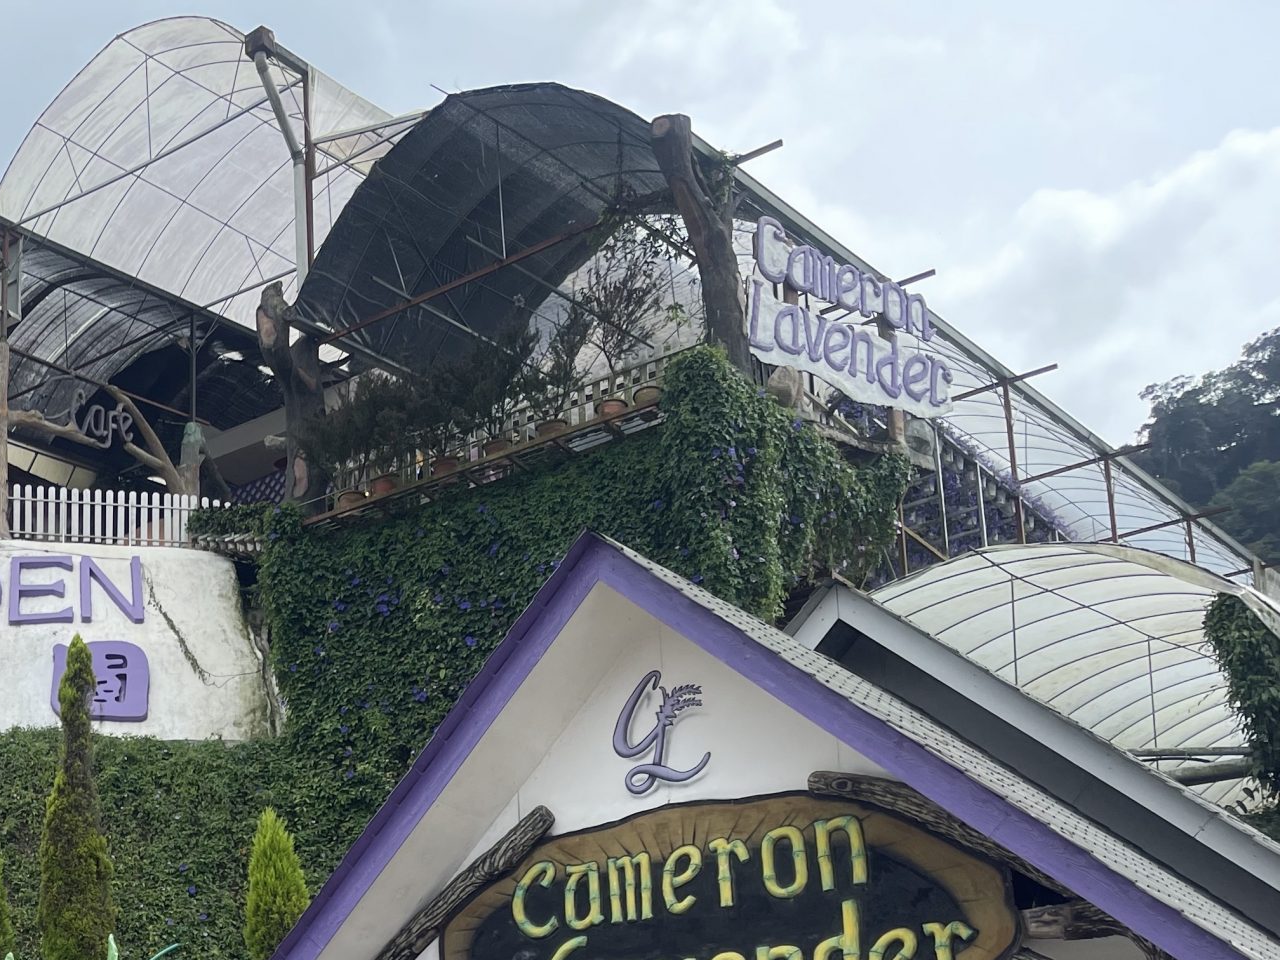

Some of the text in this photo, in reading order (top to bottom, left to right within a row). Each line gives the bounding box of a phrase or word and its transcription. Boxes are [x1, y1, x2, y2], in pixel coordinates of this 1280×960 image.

[756, 215, 937, 342] Cameron
[749, 279, 954, 407] Lavender
[511, 814, 868, 939] Cameron
